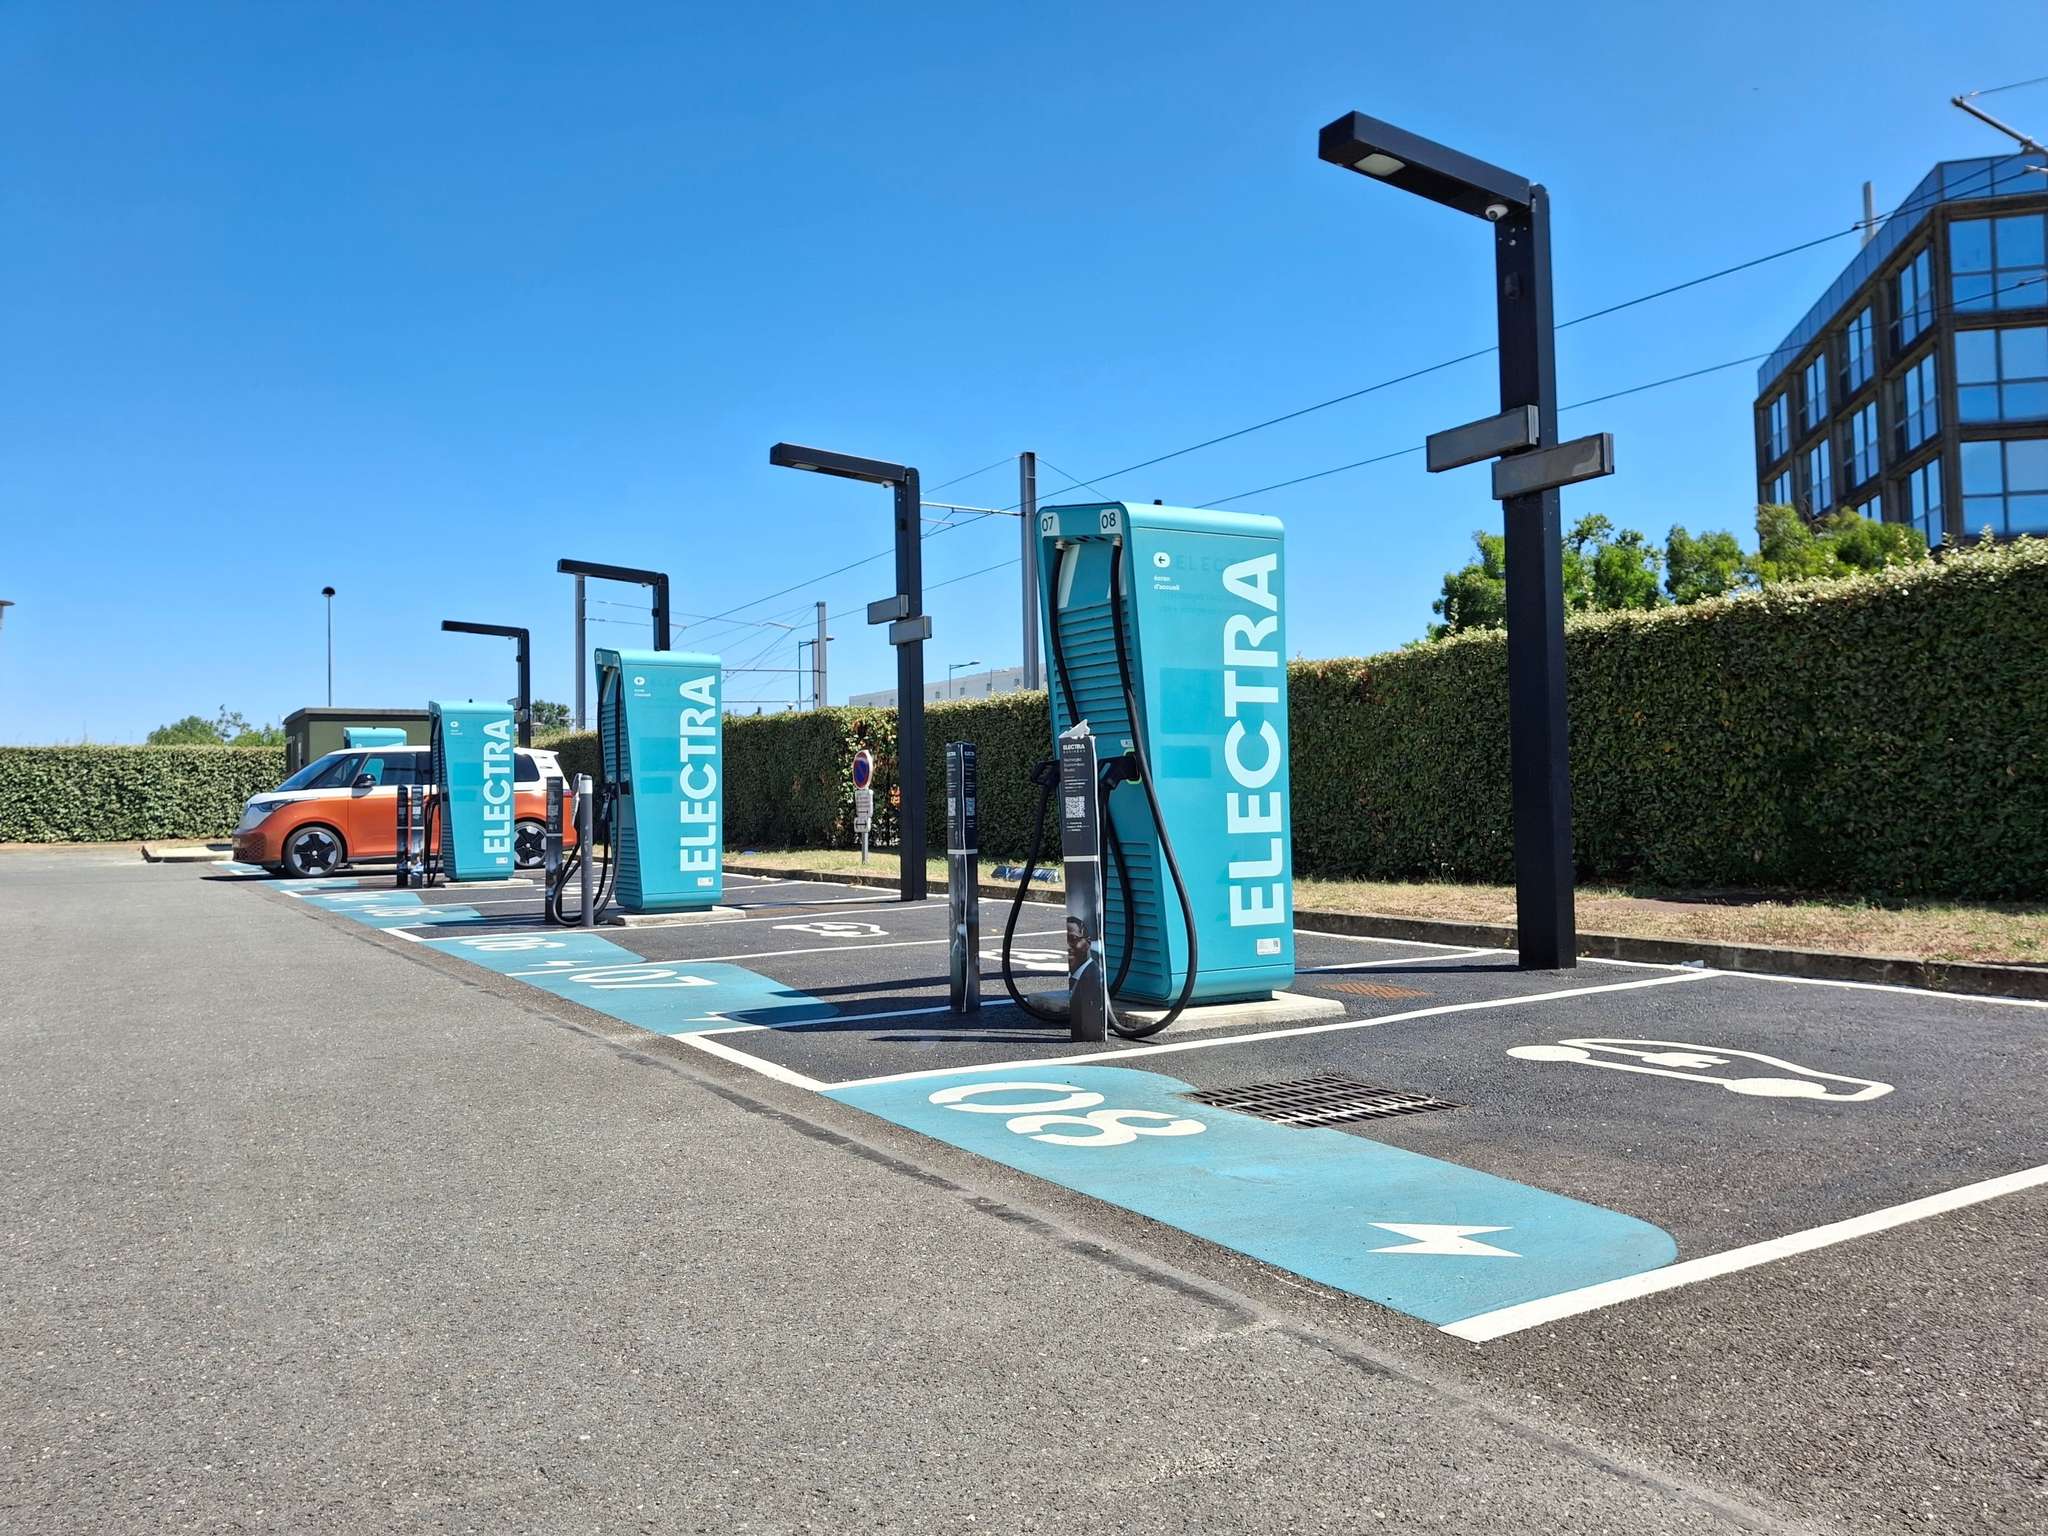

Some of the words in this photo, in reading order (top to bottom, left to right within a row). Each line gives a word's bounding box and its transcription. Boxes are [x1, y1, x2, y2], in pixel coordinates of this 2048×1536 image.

[1042, 516, 1053, 532] 07
[1101, 512, 1116, 529] 08
[1222, 553, 1285, 927] ELECTRA
[483, 719, 511, 854] ELECTRA
[679, 675, 717, 872] ELECTRA
[569, 969, 719, 989] 07
[928, 1081, 1207, 1147] 08
